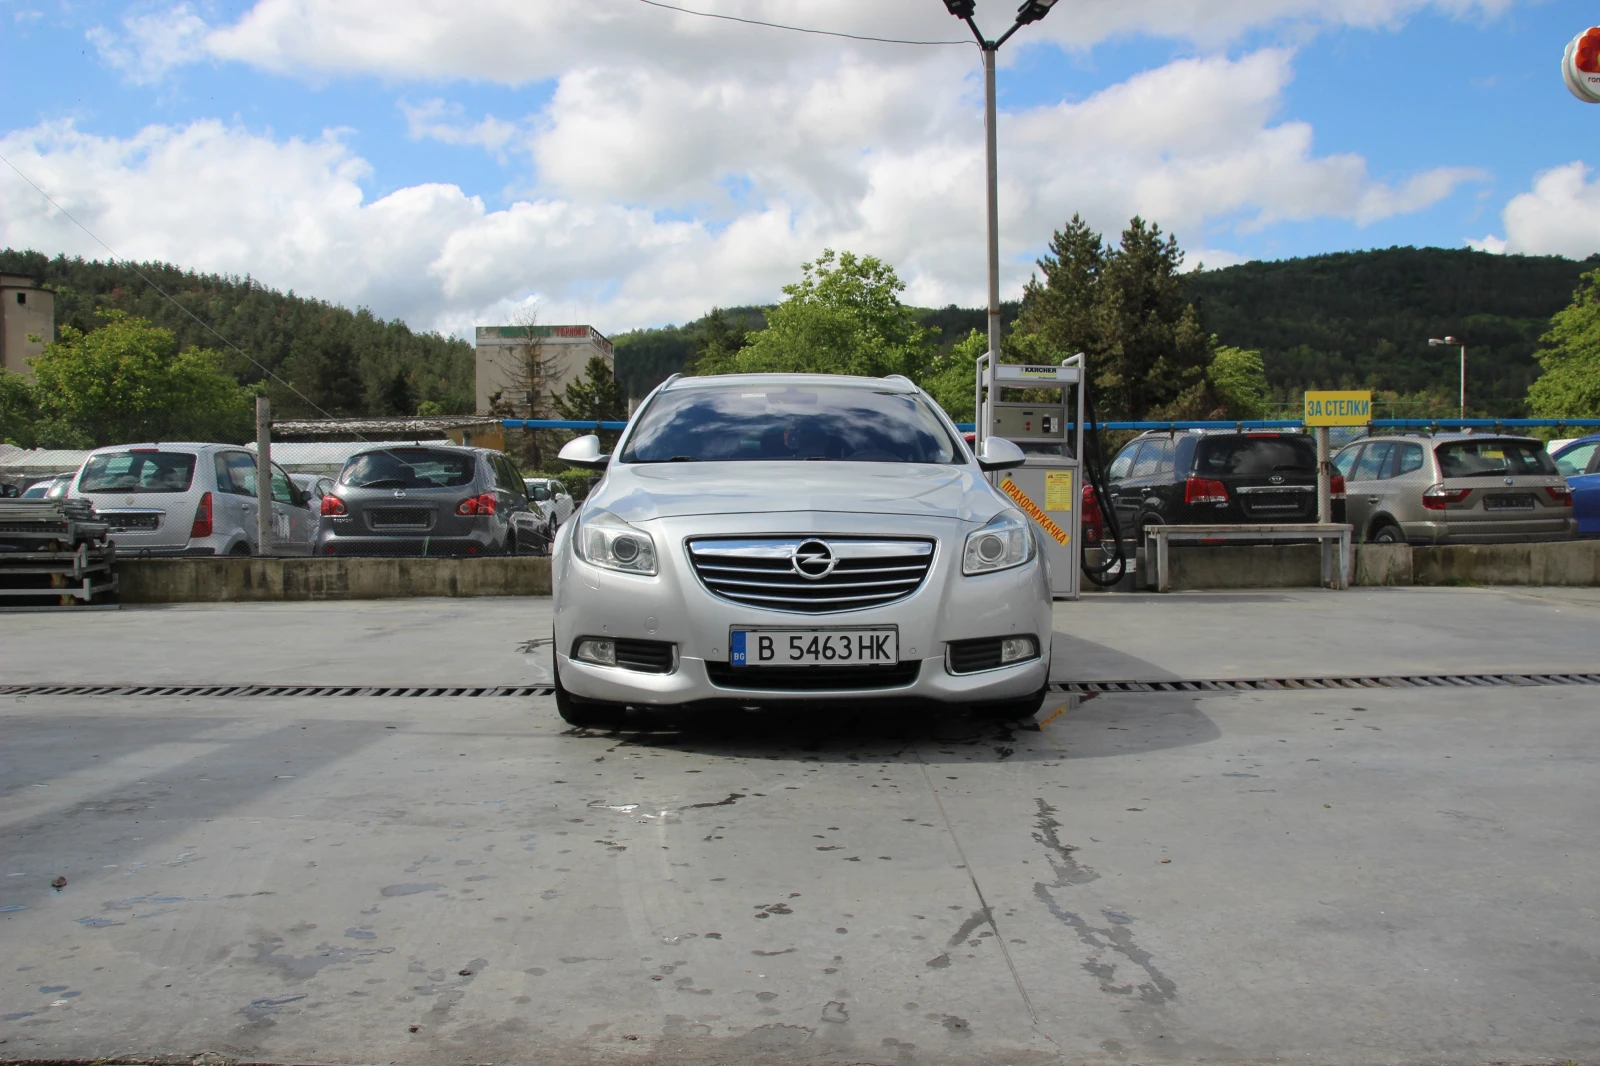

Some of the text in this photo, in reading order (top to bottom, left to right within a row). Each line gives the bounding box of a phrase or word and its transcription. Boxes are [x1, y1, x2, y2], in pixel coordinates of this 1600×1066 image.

[1308, 400, 1369, 416] ЗА СТЕЛКИ
[1002, 480, 1067, 544] ПРАХОСМУКАЧКА
[758, 635, 891, 661] B 5463 HK
